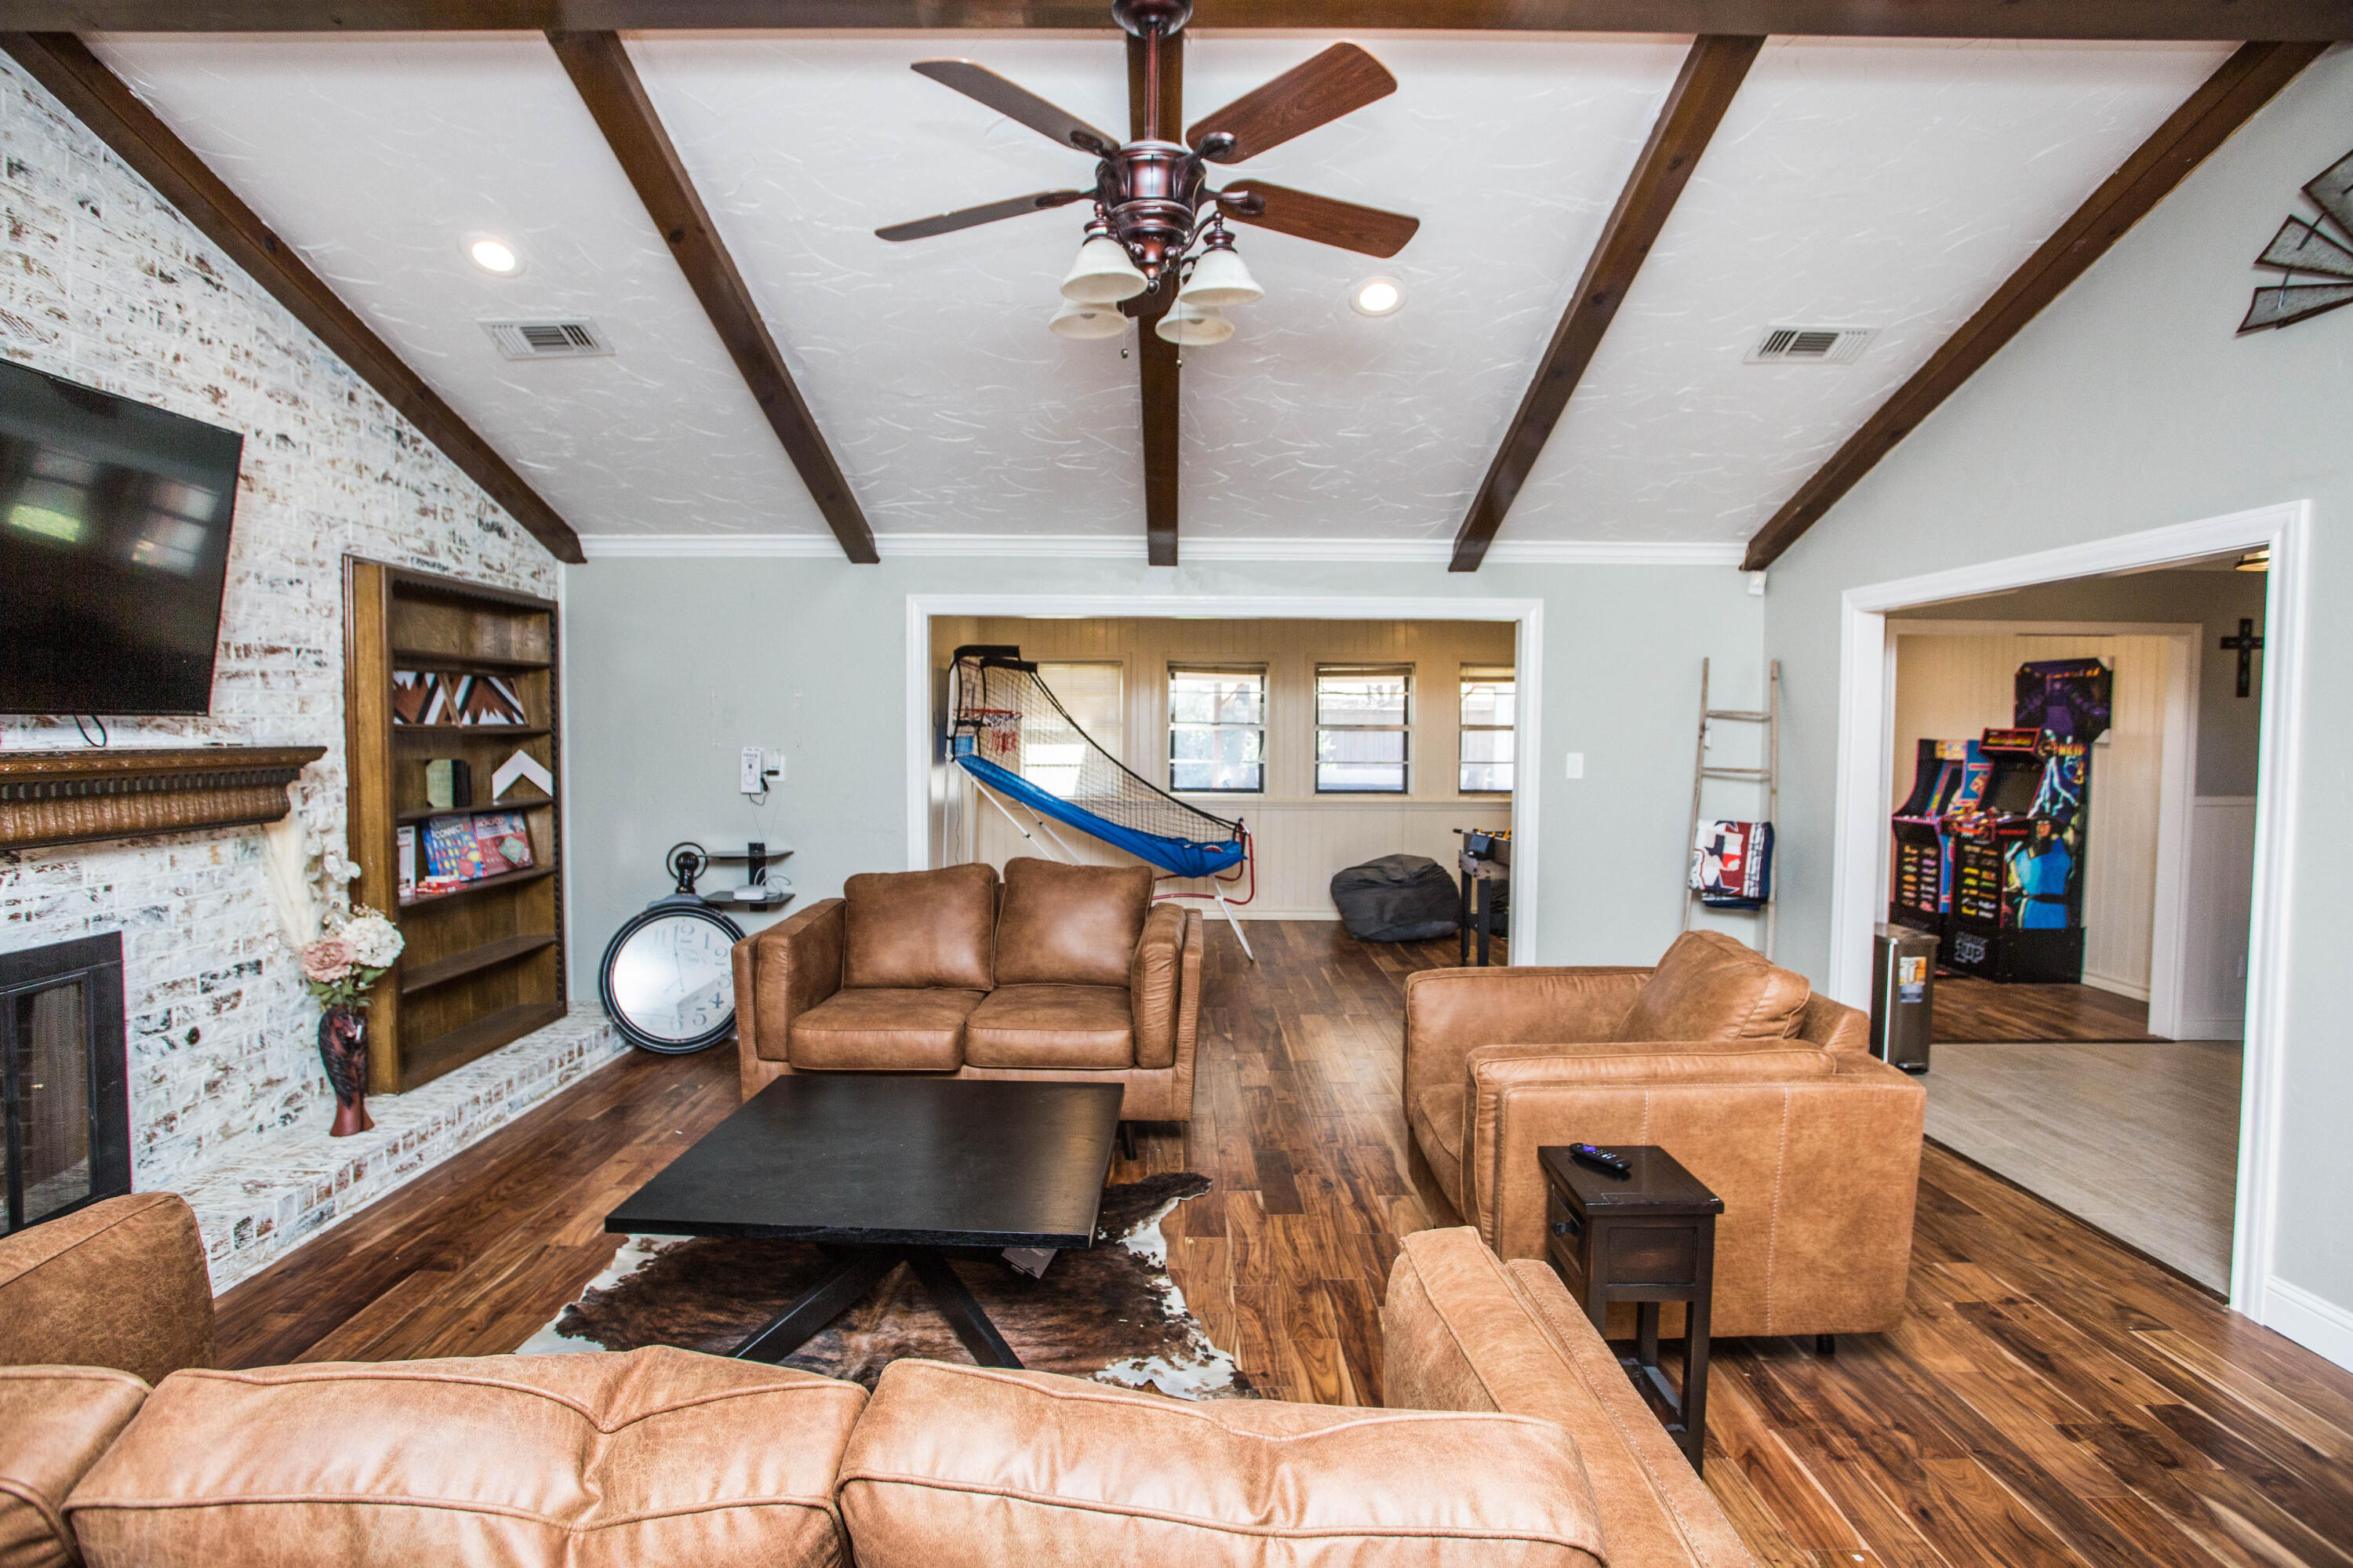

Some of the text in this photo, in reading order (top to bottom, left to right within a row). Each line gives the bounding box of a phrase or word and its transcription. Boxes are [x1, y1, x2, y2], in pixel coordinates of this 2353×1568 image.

[434, 823, 464, 840] CONNECT
[674, 924, 695, 944] 12
[704, 931, 710, 950] 1
[715, 947, 729, 966] 2
[718, 970, 732, 989] 3
[709, 991, 725, 1010] 4
[693, 1007, 707, 1027] 5
